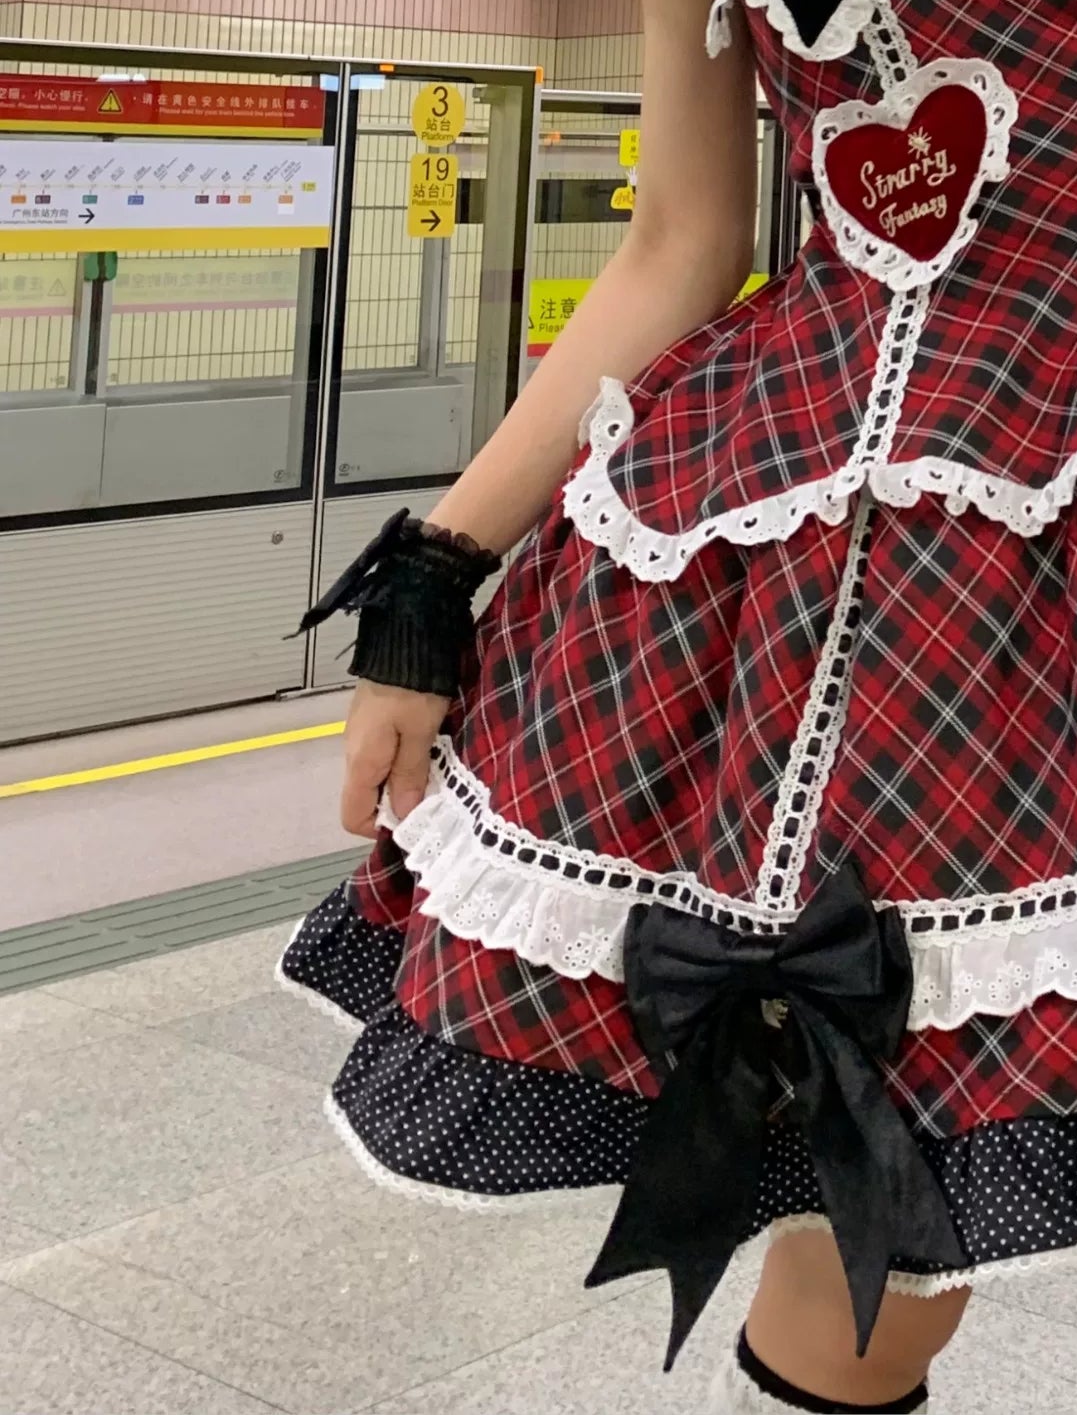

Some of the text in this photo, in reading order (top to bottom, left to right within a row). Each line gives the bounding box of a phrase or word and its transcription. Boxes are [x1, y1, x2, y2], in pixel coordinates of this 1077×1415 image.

[432, 86, 448, 117] 3
[426, 117, 451, 131] 站台
[421, 131, 454, 141] Platform
[422, 157, 449, 181] 19
[413, 183, 455, 199] 站台门
[879, 194, 947, 237] Fantasy
[539, 297, 577, 320] 注意
